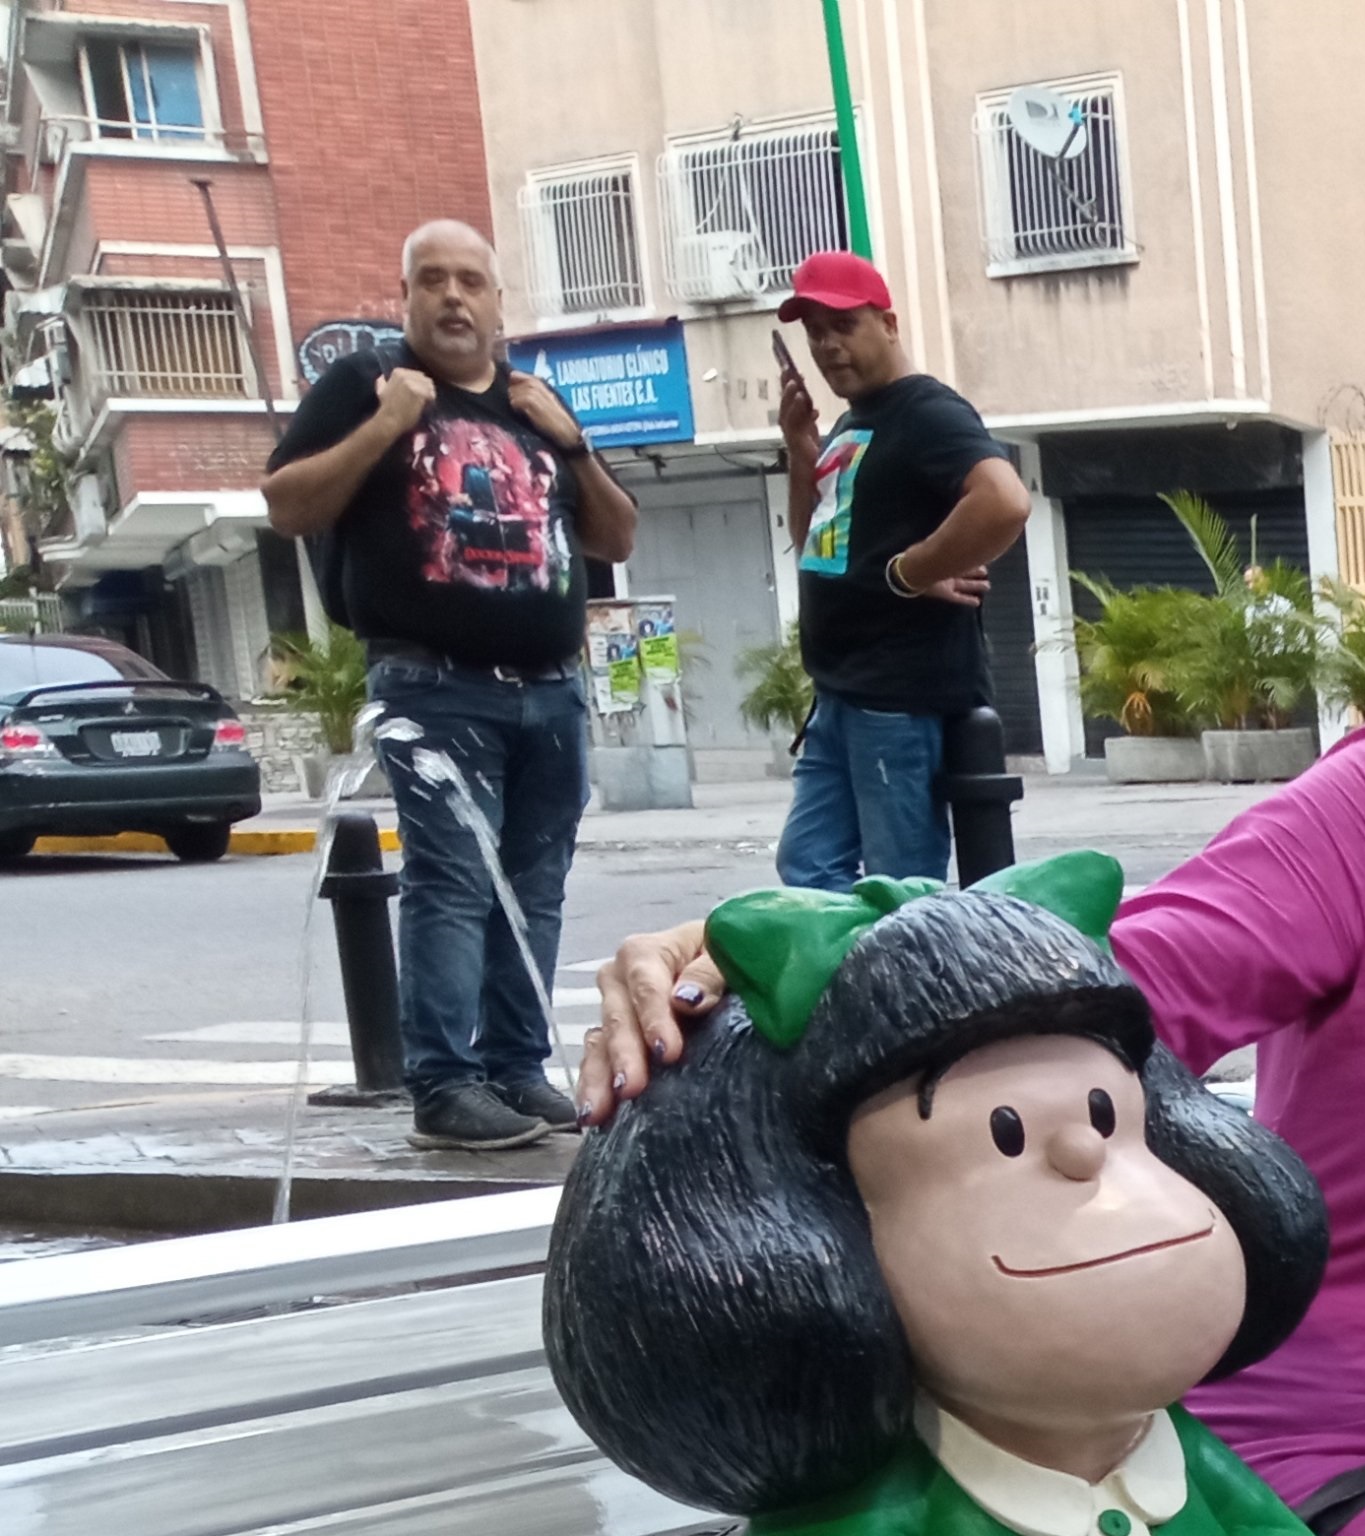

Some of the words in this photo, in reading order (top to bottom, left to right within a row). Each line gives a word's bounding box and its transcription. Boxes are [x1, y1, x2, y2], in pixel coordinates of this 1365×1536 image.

[556, 353, 625, 386] LABORATORIO
[625, 344, 669, 378] CLÍNICO
[570, 385, 592, 412] LAS
[591, 380, 634, 410] FUENTES
